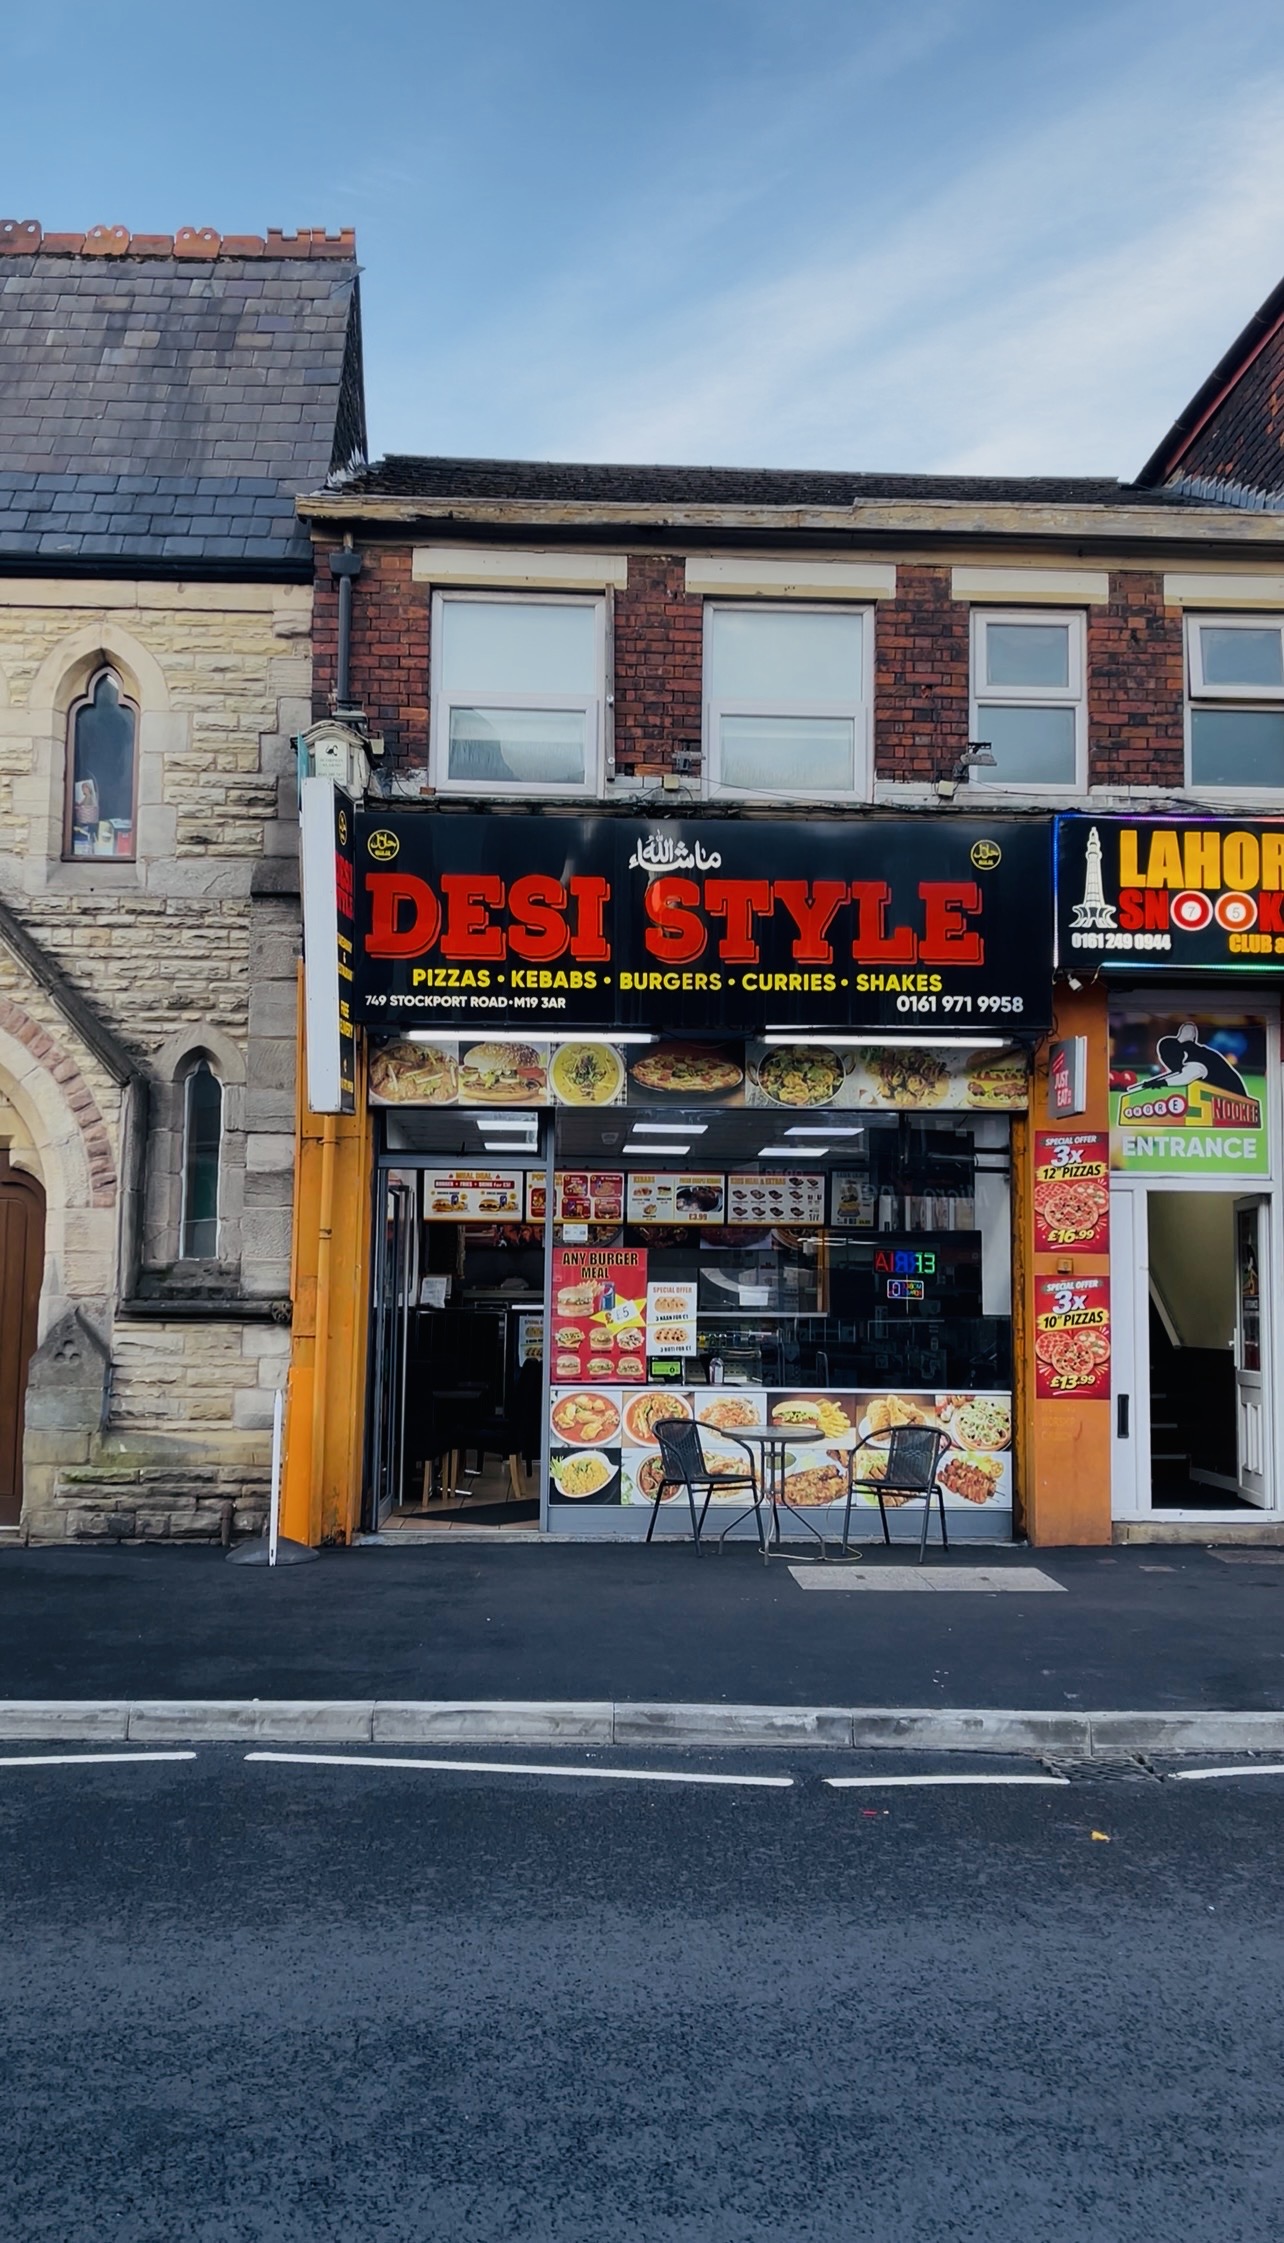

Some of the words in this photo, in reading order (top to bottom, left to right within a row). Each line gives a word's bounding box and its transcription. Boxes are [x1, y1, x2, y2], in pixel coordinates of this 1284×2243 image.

[365, 873, 611, 962] DESI
[645, 877, 984, 965] STYLE
[1071, 932, 1104, 949] 0161
[1105, 933, 1133, 949] 249
[1134, 933, 1171, 950] 0944
[1228, 933, 1273, 954] CLUB
[412, 968, 491, 988] PIZZAS
[511, 969, 597, 989] KEBABS
[620, 972, 721, 991] BURGERS
[742, 973, 836, 992] CURRIES
[856, 974, 943, 992] SHAKES
[365, 995, 387, 1006] 749
[390, 995, 467, 1008] STOCKPORT
[471, 996, 507, 1008] ROAD
[514, 996, 538, 1008] M19
[541, 997, 566, 1009] 3AR
[896, 995, 937, 1013] 0161
[941, 995, 972, 1013] 971
[977, 995, 1024, 1013] 9958
[1054, 1070, 1069, 1090] JUST
[1045, 1136, 1073, 1146] SPECIAL
[1074, 1135, 1097, 1144] OFFER
[1121, 1136, 1257, 1159] ENTRANCE
[1051, 1145, 1085, 1168] 3x
[1062, 1164, 1102, 1178] PIZZAS
[1047, 1229, 1095, 1244] £16.99
[562, 1252, 586, 1265] ANY
[589, 1252, 638, 1265] BURGER
[581, 1267, 609, 1279] MEAL
[653, 1286, 675, 1294] SPECIAL
[1046, 1282, 1075, 1292] SPECIAL
[1075, 1279, 1099, 1289] OFFER
[1052, 1290, 1087, 1314] 3x
[1063, 1311, 1104, 1326] PIZZAS
[1050, 1375, 1096, 1390] £13.99
